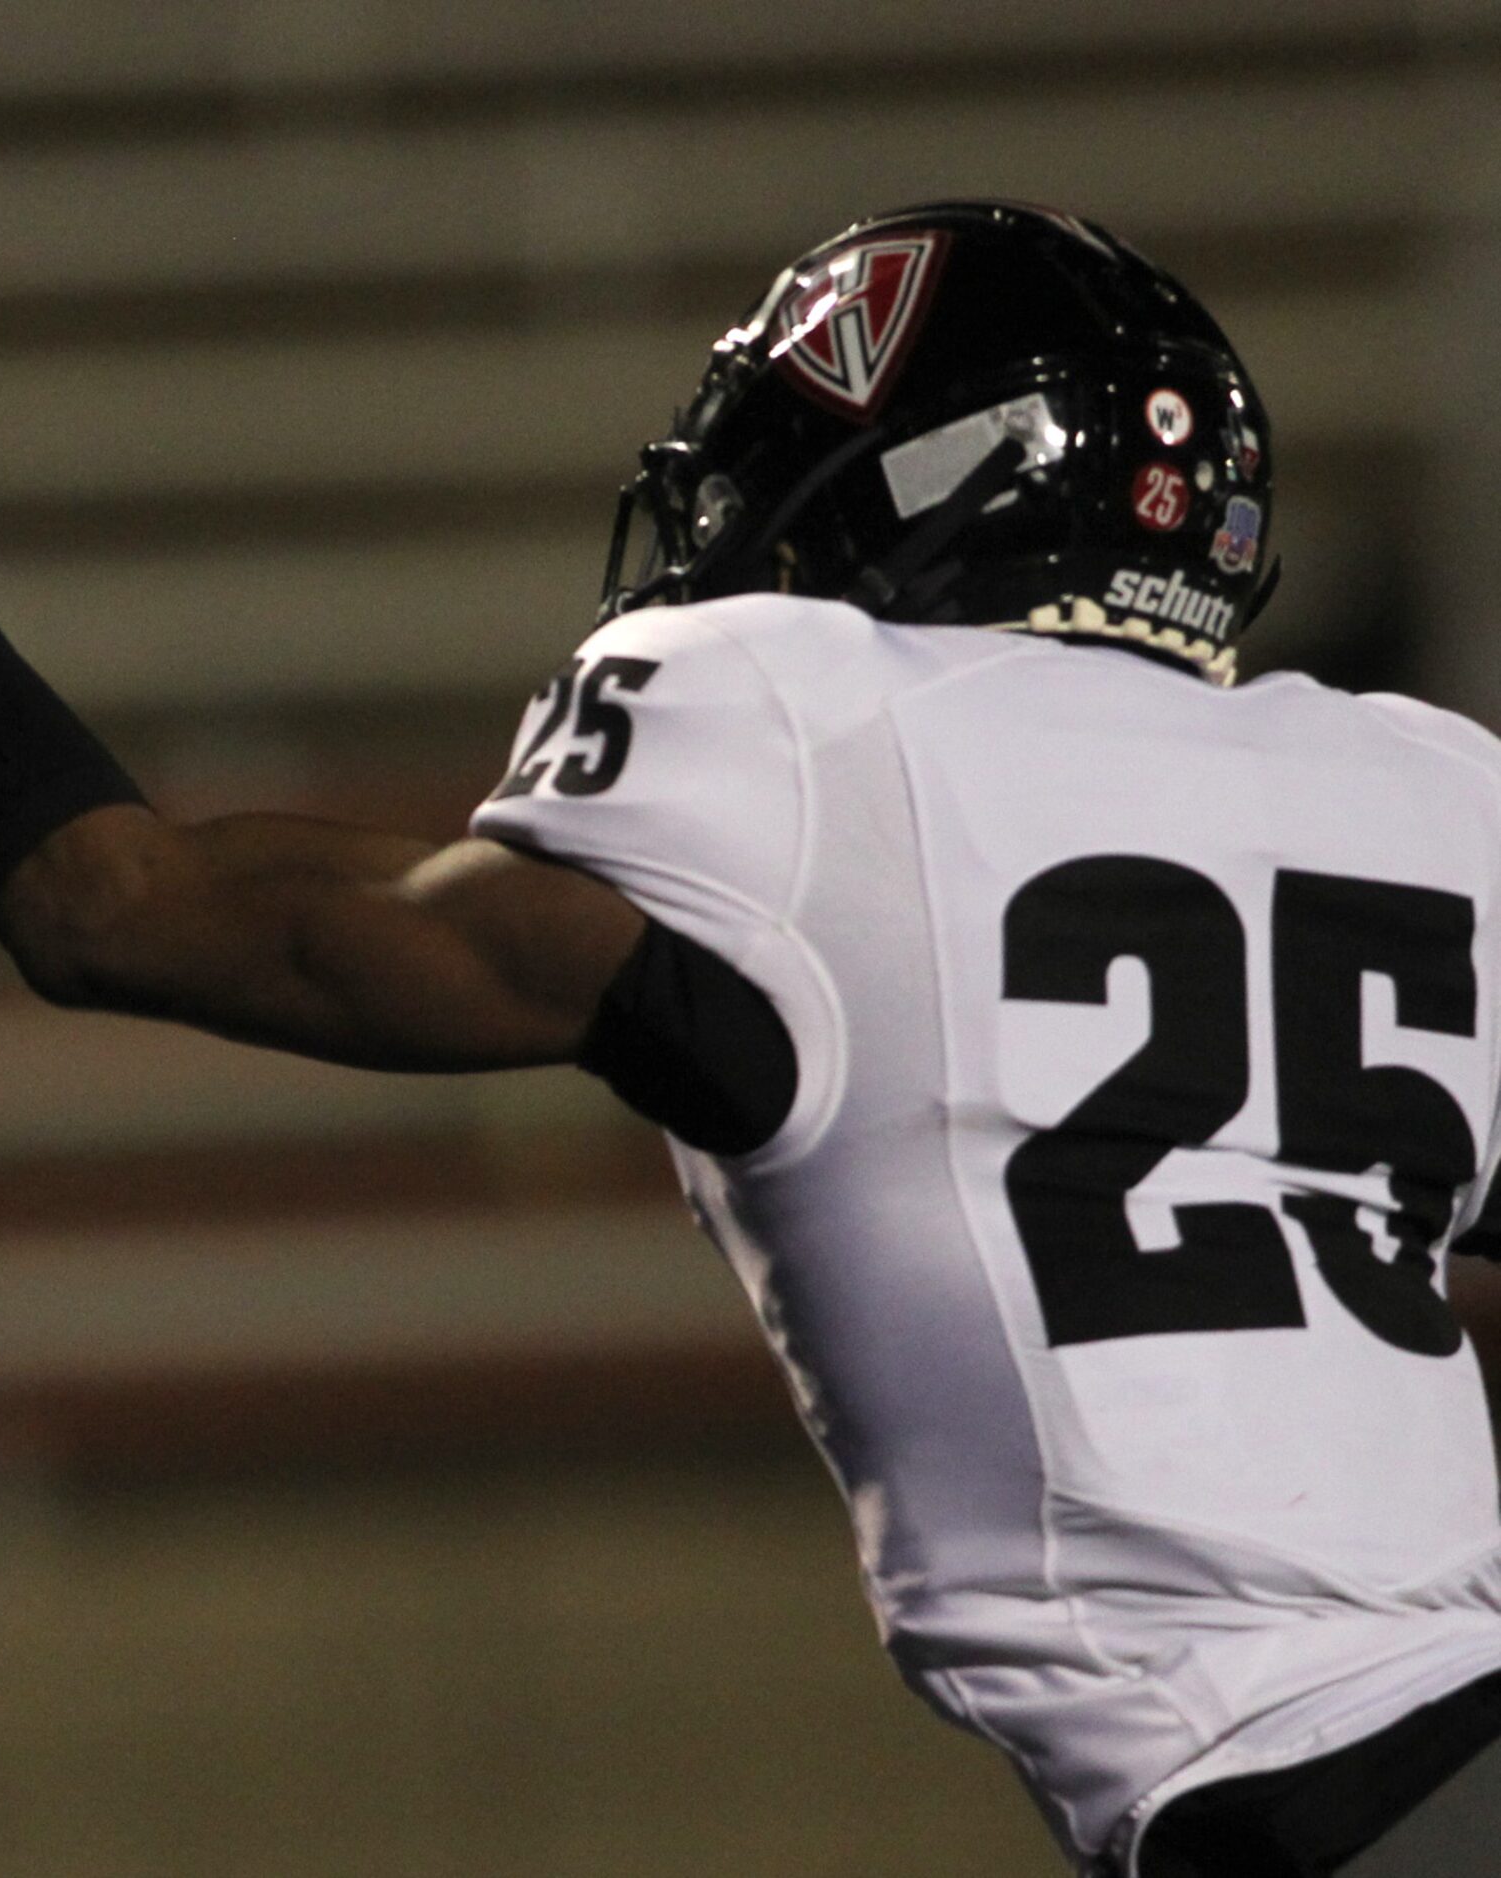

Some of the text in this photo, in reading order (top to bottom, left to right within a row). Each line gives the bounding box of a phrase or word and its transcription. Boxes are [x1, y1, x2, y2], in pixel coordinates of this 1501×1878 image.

[1136, 467, 1184, 525] 25
[1103, 569, 1235, 640] schutt
[495, 656, 663, 800] 25
[1002, 853, 1477, 1358] 25
